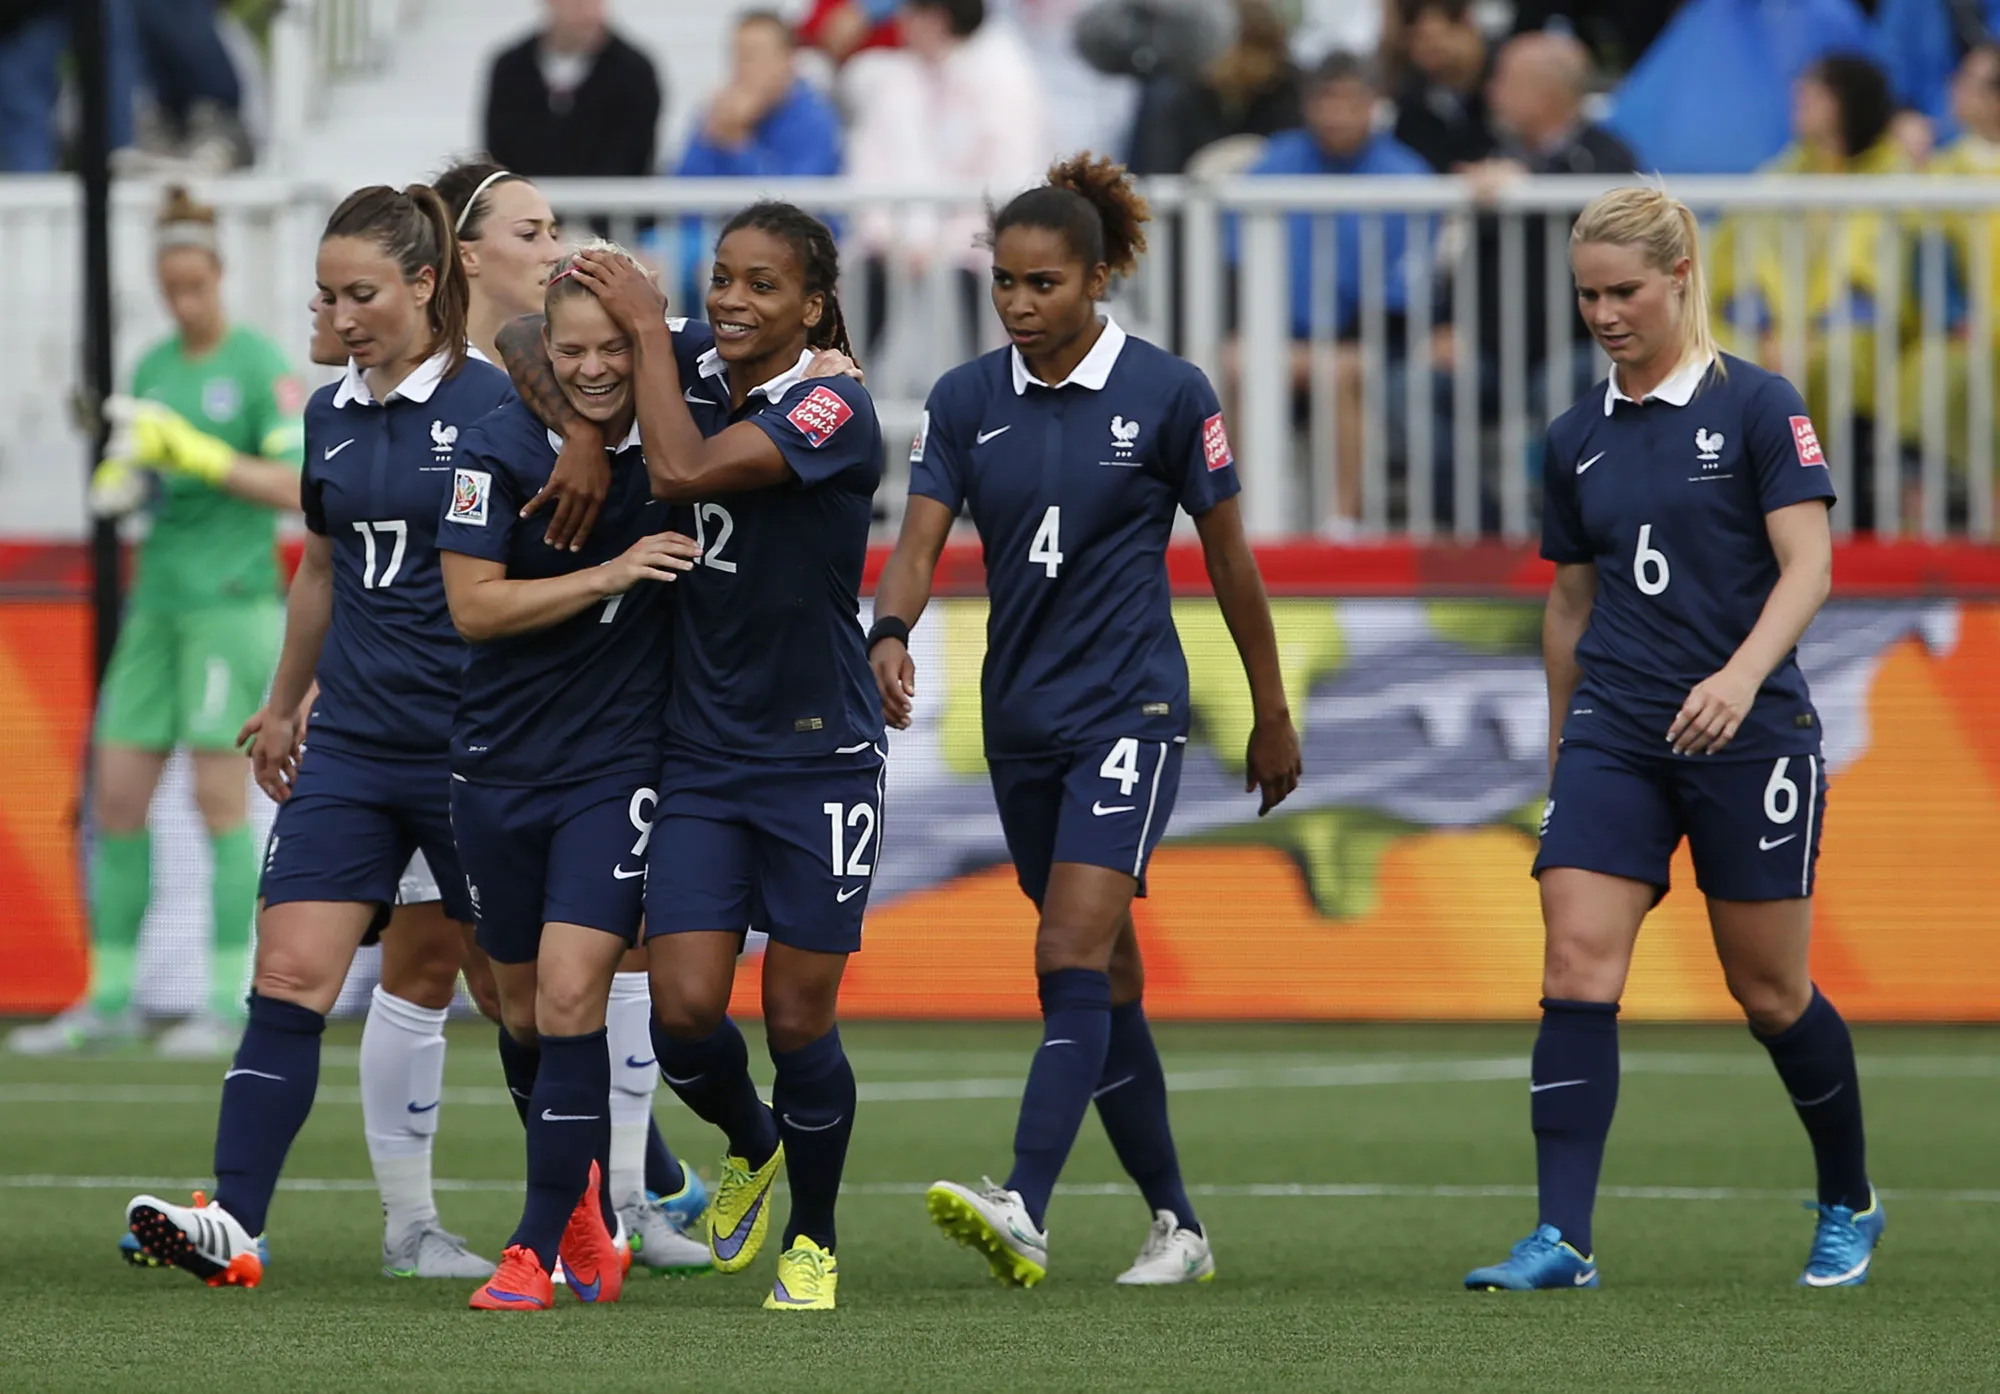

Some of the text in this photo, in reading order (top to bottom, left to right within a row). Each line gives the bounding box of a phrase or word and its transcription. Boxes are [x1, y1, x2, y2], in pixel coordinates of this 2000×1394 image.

[796, 409, 833, 434] GOALS
[805, 401, 837, 425] YOUR
[812, 394, 841, 412] LIVE
[352, 520, 407, 589] 17
[693, 502, 737, 573] 12
[1028, 505, 1063, 578] 4
[1633, 523, 1670, 595] 6
[1099, 737, 1140, 796] 4
[1763, 756, 1798, 824] 6
[629, 787, 659, 857] 9
[824, 802, 875, 877] 12
